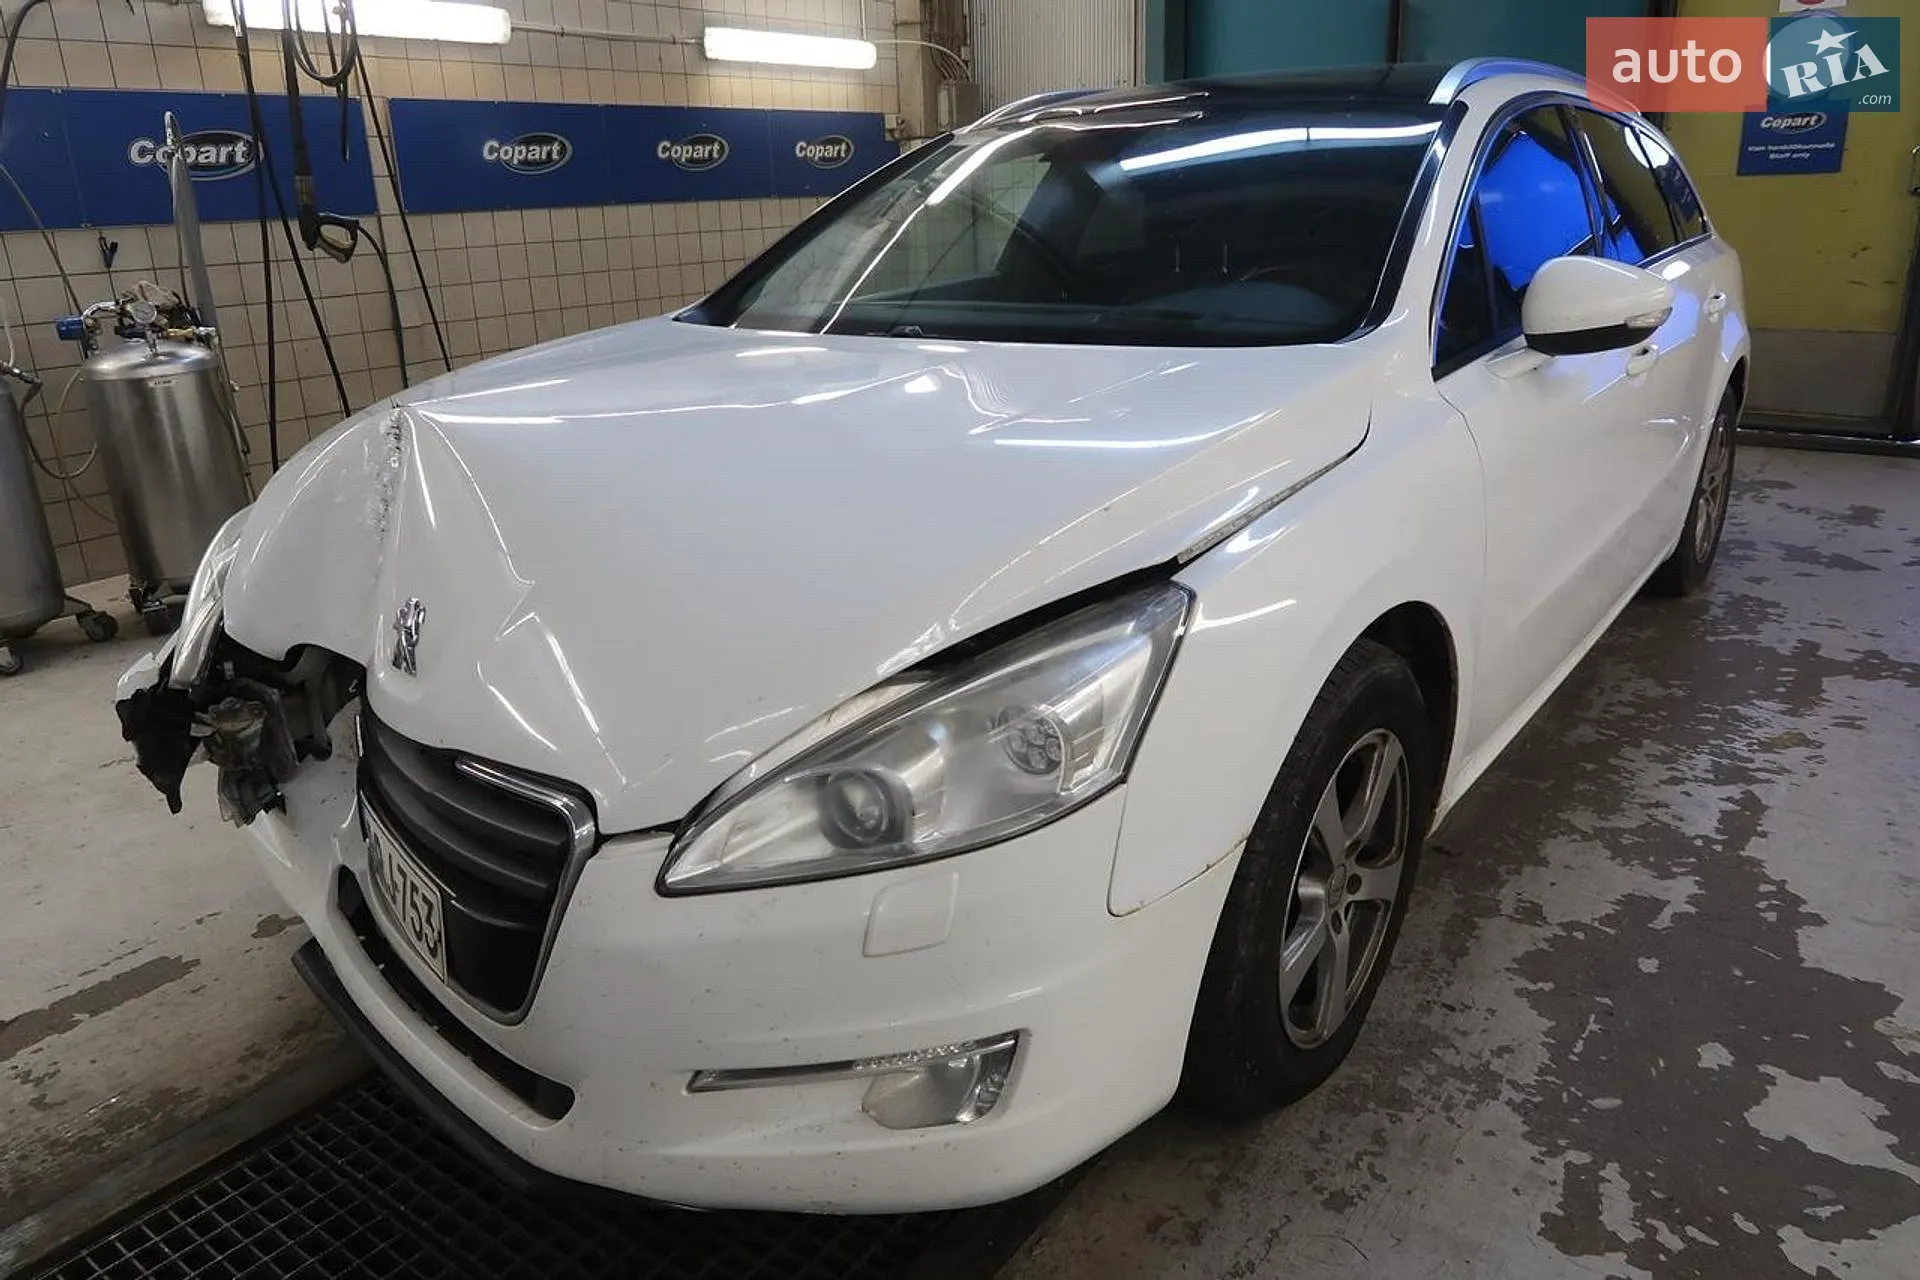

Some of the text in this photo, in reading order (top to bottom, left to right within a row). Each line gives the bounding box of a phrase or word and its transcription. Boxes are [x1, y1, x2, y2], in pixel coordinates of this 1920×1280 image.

[1760, 115, 1819, 129] Copart
[482, 140, 562, 165] Copart
[657, 141, 721, 162] Copart
[795, 141, 847, 161] Copart
